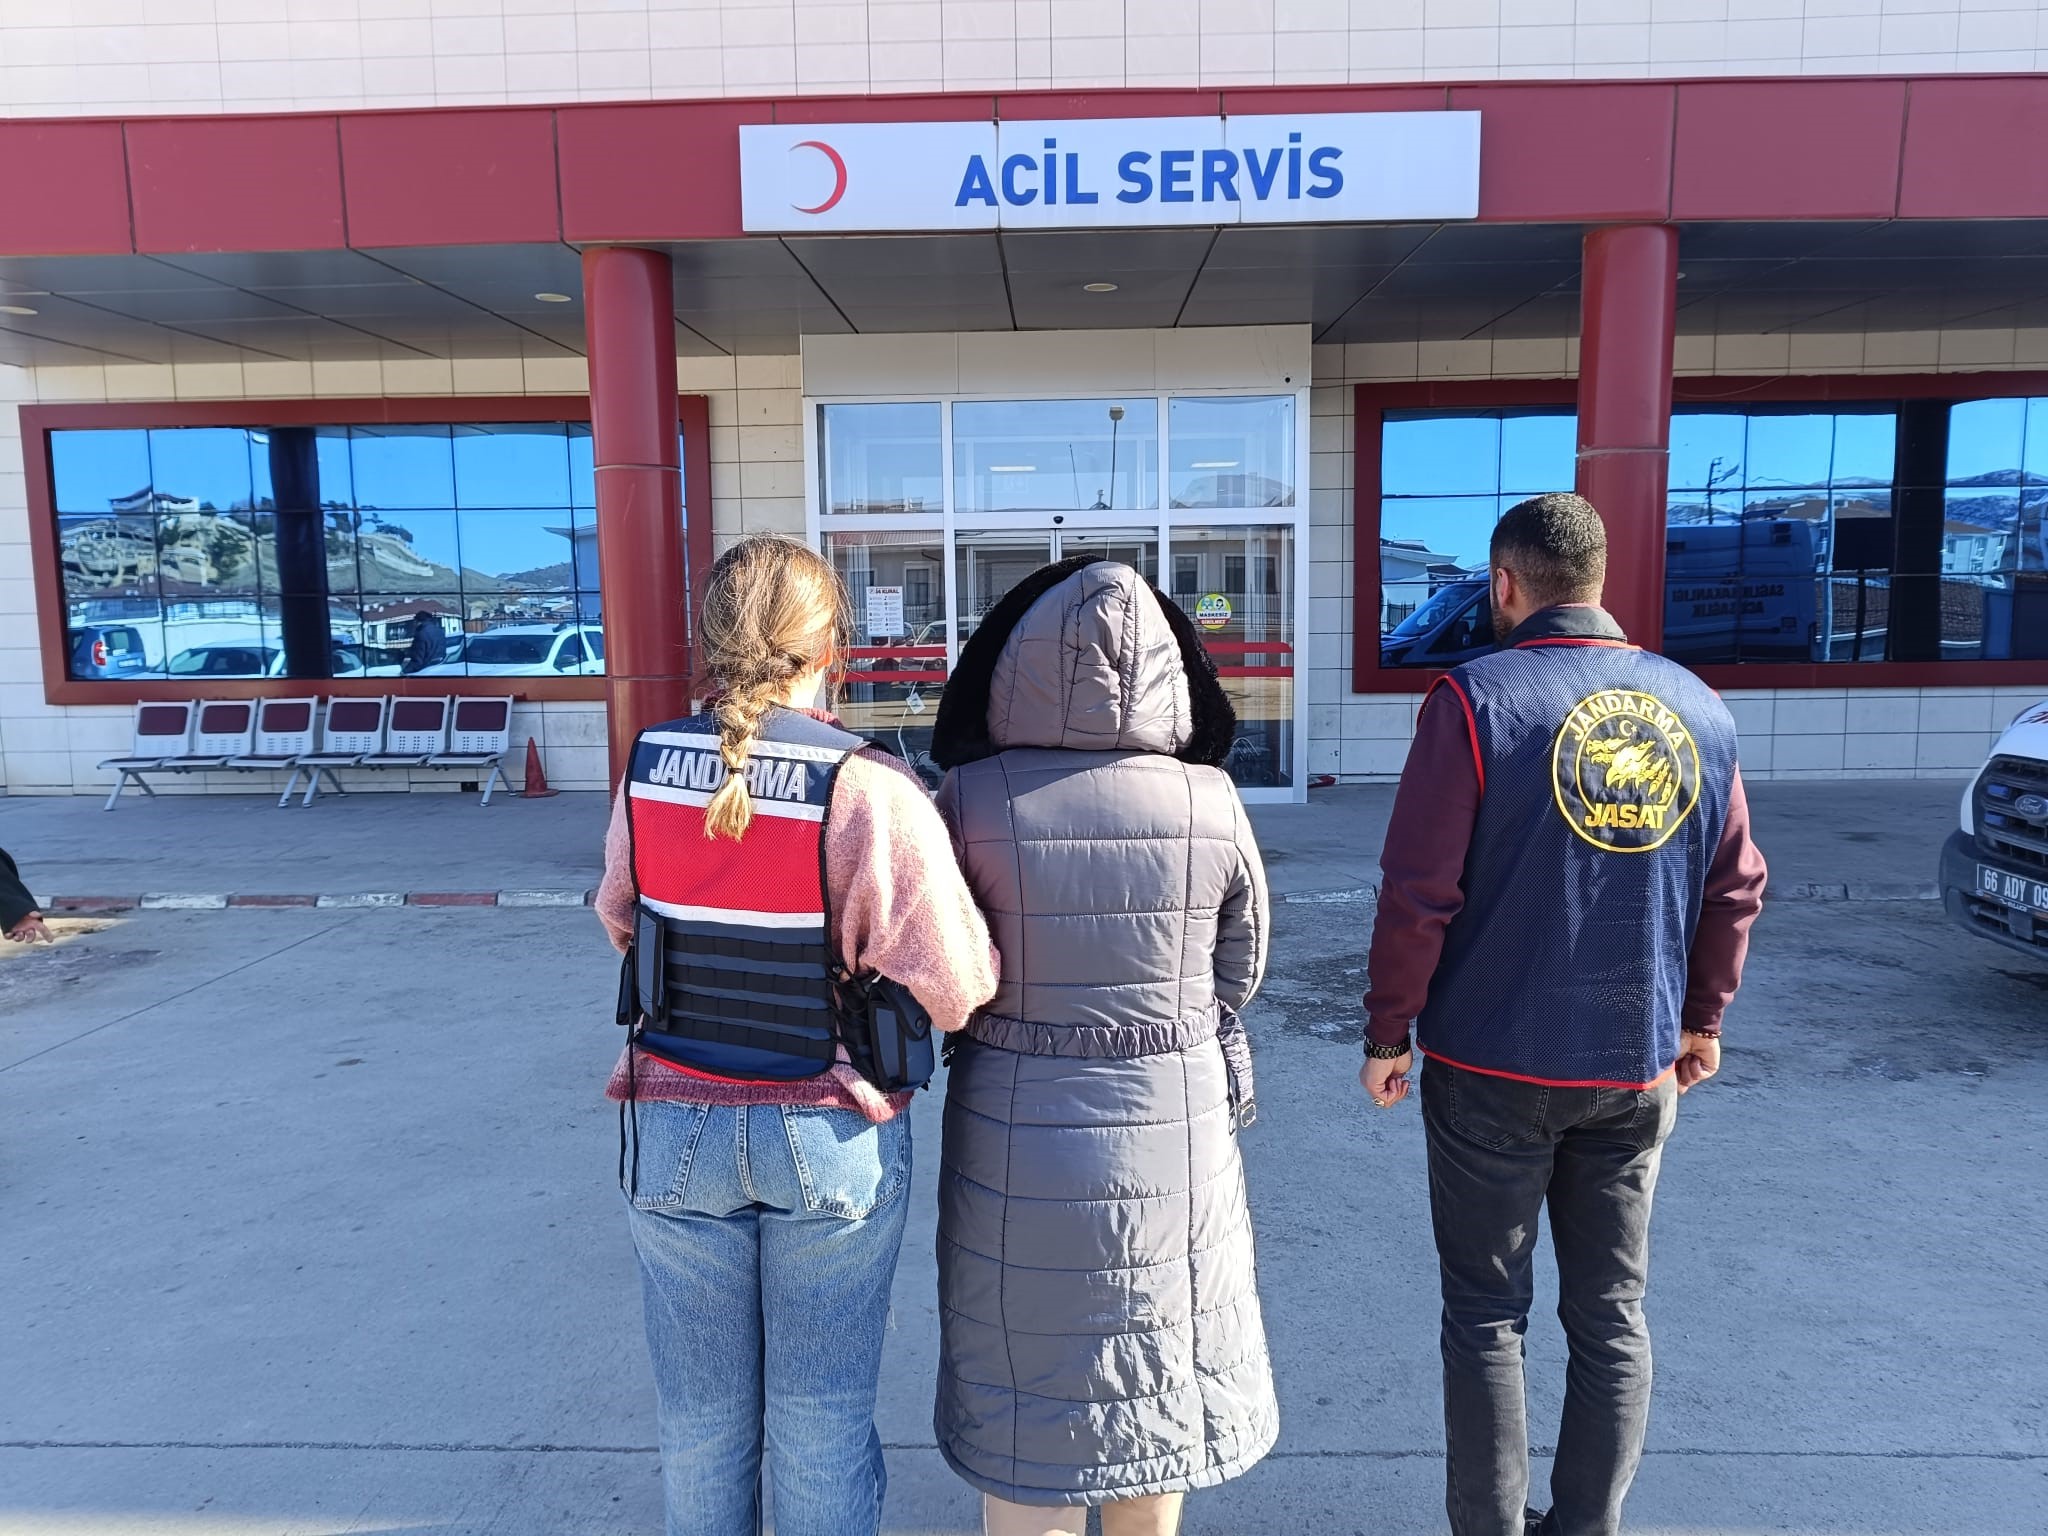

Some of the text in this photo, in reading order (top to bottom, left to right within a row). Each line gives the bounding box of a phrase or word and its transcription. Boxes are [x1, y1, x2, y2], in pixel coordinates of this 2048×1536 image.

[954, 132, 1344, 207] ACİL SERVİS
[1569, 695, 1686, 750] JANDARMA
[649, 749, 806, 801] JANDRMA
[1585, 803, 1669, 829] JASAT
[2019, 798, 2042, 814] Ford
[1984, 868, 1998, 896] 66
[2004, 876, 2028, 902] ADY
